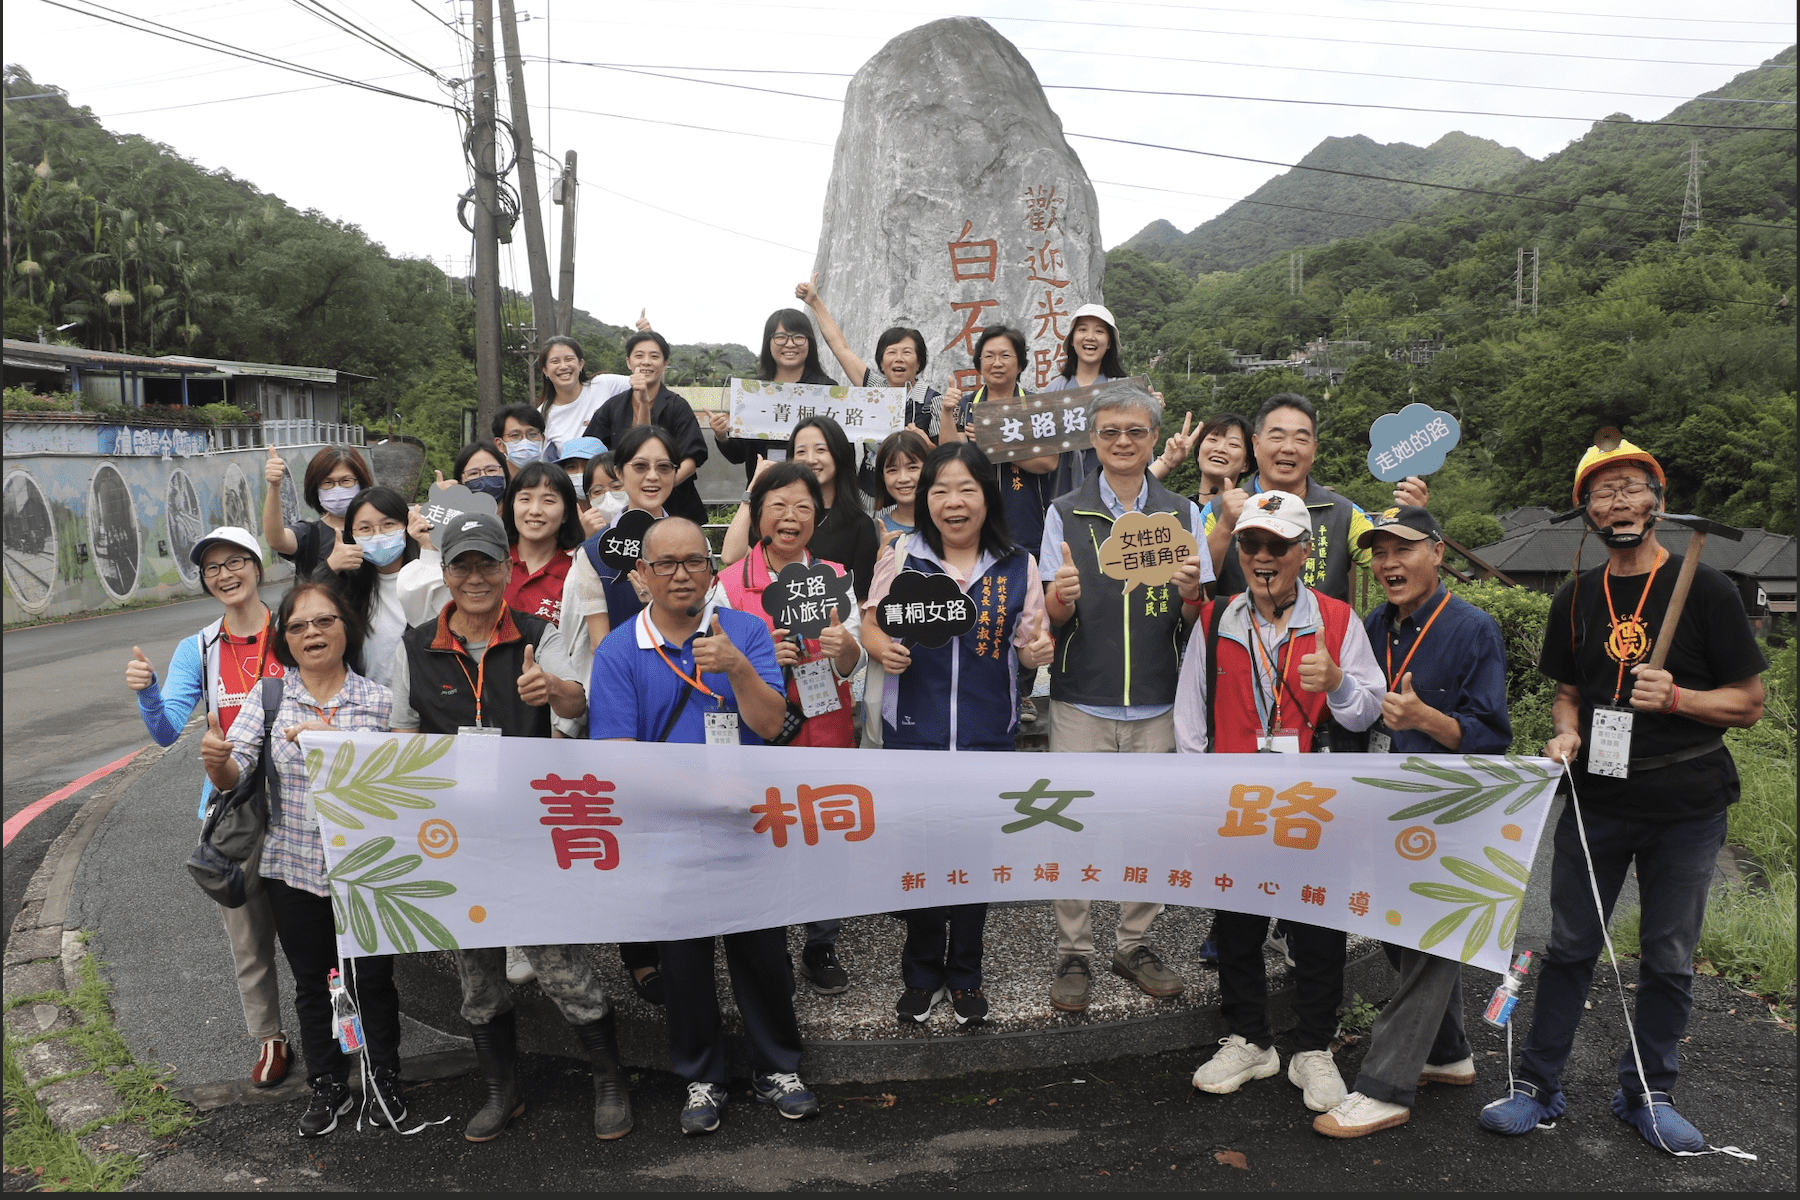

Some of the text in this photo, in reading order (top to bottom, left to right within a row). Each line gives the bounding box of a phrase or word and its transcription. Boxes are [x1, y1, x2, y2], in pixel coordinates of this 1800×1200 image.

[999, 407, 1088, 443] 女路好
[1374, 416, 1450, 475] 走她的路
[605, 536, 641, 558] 女路
[1119, 527, 1171, 551] 女性的
[1317, 524, 1329, 582] 平溪區公所
[1104, 544, 1191, 571] 一百種角色
[786, 575, 826, 600] 女路
[1159, 580, 1170, 613] 溪區
[780, 598, 838, 625] 小旅行
[884, 599, 967, 626] 菁桐女路
[975, 576, 992, 656] 副局長 吳淑芳
[530, 773, 1338, 871] 菁桐女路
[901, 862, 1371, 917] 新北市婦女服務中心輔導
